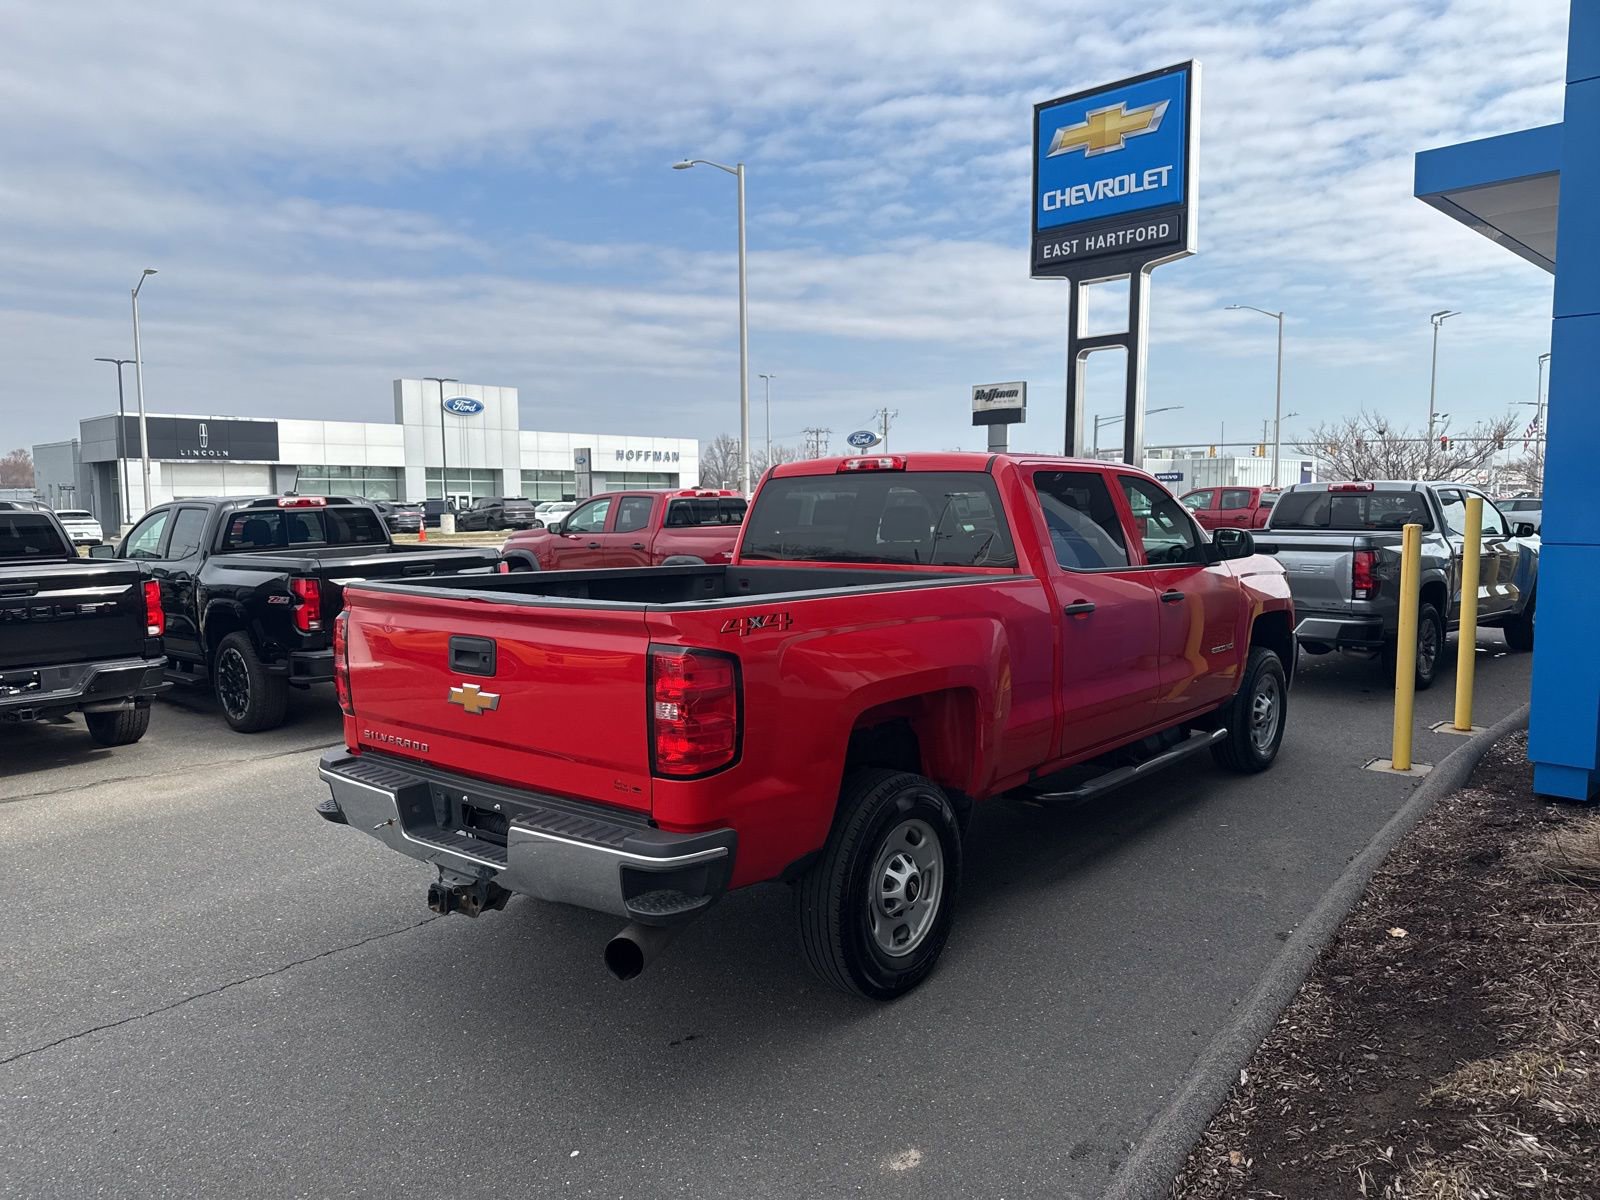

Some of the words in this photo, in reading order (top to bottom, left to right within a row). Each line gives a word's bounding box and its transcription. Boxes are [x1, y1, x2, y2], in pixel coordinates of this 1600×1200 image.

[1043, 165, 1173, 211] CHEVROLET
[1043, 240, 1079, 259] EAST
[1085, 223, 1169, 251] HARTFORD
[974, 388, 1019, 402] Hoffman
[452, 399, 477, 412] Ford
[852, 433, 871, 445] Ford
[180, 449, 229, 457] LINCOLN
[615, 449, 680, 462] HOFFMAN
[363, 729, 430, 753] SILVERADO
